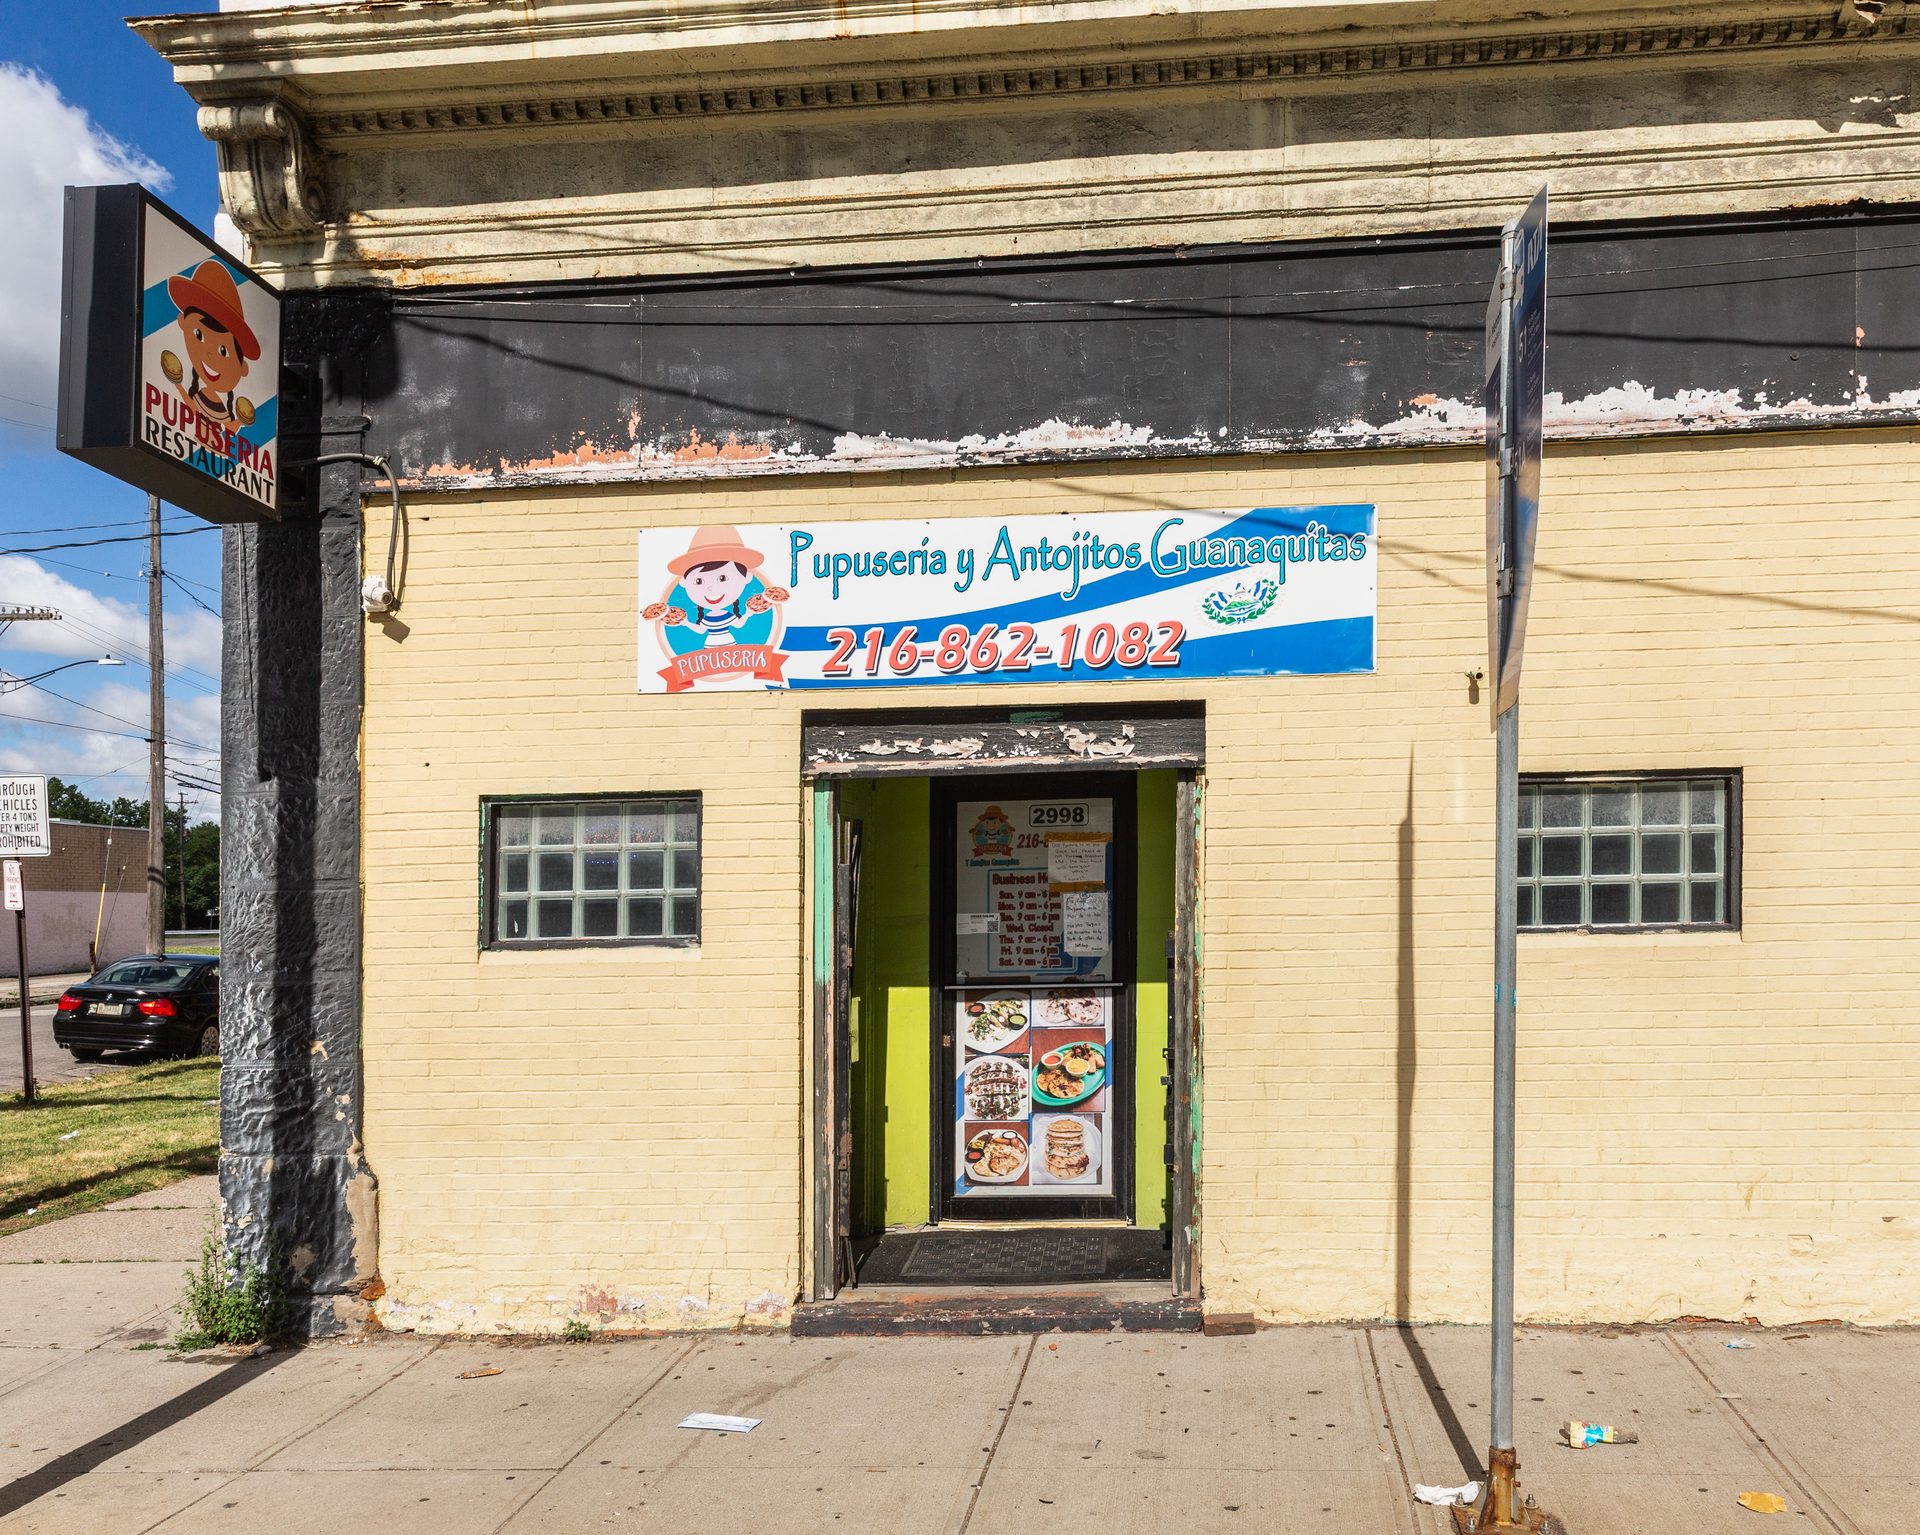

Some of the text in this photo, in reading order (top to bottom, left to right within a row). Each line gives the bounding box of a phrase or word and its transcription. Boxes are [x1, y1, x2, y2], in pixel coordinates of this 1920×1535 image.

[145, 382, 274, 480] PUPUSERIA
[145, 416, 274, 504] RESTAURANT
[954, 547, 974, 593] y
[982, 525, 1142, 598] Antojitos
[822, 620, 1185, 678] 216-862-1082
[677, 649, 768, 678] PUPUSERIA
[0, 783, 36, 796] ROUGH
[0, 798, 38, 811] HICLES
[0, 812, 37, 822] ER 4 TONS
[1032, 806, 1085, 824] 2998
[0, 822, 39, 833] PTY WEIGHT
[992, 872, 1036, 885] Business
[1019, 901, 1024, 910] 9
[1025, 902, 1037, 910] am
[1043, 901, 1049, 909] 6
[1049, 902, 1062, 912] pm
[1017, 912, 1023, 921] 9
[1023, 913, 1036, 921] am
[1042, 912, 1047, 920] 6
[1048, 913, 1060, 923] pm
[1028, 922, 1054, 932] Closed
[1042, 934, 1048, 943] 6
[1048, 936, 1061, 946] pm
[1016, 945, 1021, 955] 9
[1022, 947, 1034, 955] am
[1040, 945, 1046, 954] 6
[1046, 947, 1059, 957] pm
[1024, 958, 1036, 966] am
[1042, 956, 1048, 965] 6
[1048, 958, 1061, 968] pm
